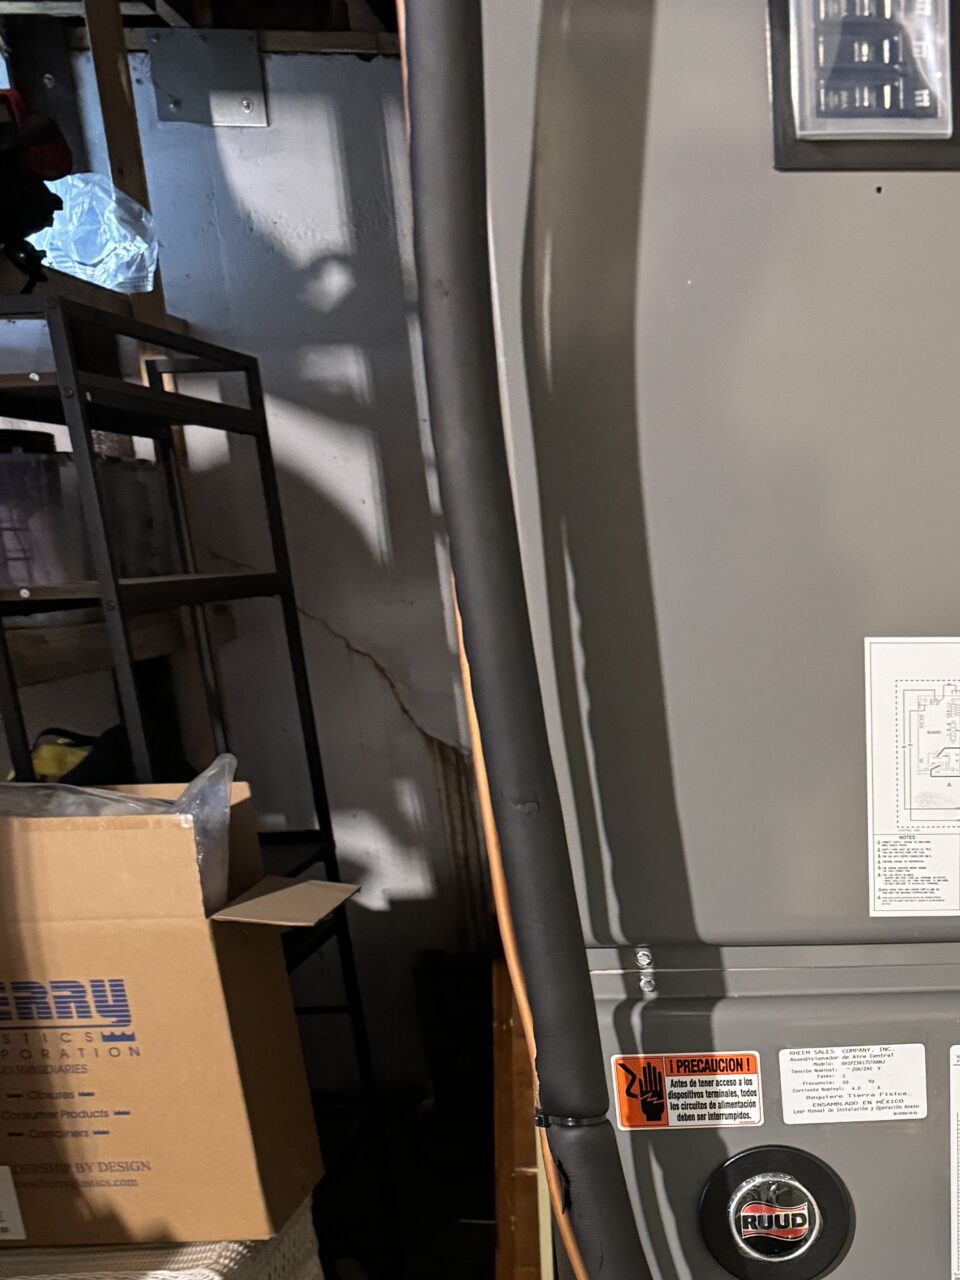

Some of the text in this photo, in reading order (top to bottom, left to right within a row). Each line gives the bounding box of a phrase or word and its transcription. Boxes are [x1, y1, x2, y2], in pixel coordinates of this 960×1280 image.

[15, 1064, 88, 1075] SUBSIDIARIES
[676, 1058, 743, 1073] PRECAUCION
[670, 1078, 688, 1088] Antes
[689, 1078, 697, 1087] de
[698, 1078, 714, 1087] tener
[743, 1077, 753, 1086] los
[668, 1090, 704, 1102] dispositivos
[740, 1089, 757, 1098] todos
[670, 1102, 679, 1110] los
[681, 1100, 707, 1110] circuitos
[709, 1100, 716, 1109] de
[61, 1108, 109, 1118] Products
[677, 1112, 696, 1121] deben
[28, 1129, 89, 1138] Containers
[76, 1162, 95, 1173] BY
[98, 1160, 152, 1172] DESIGN
[742, 1213, 807, 1229] RUUD
